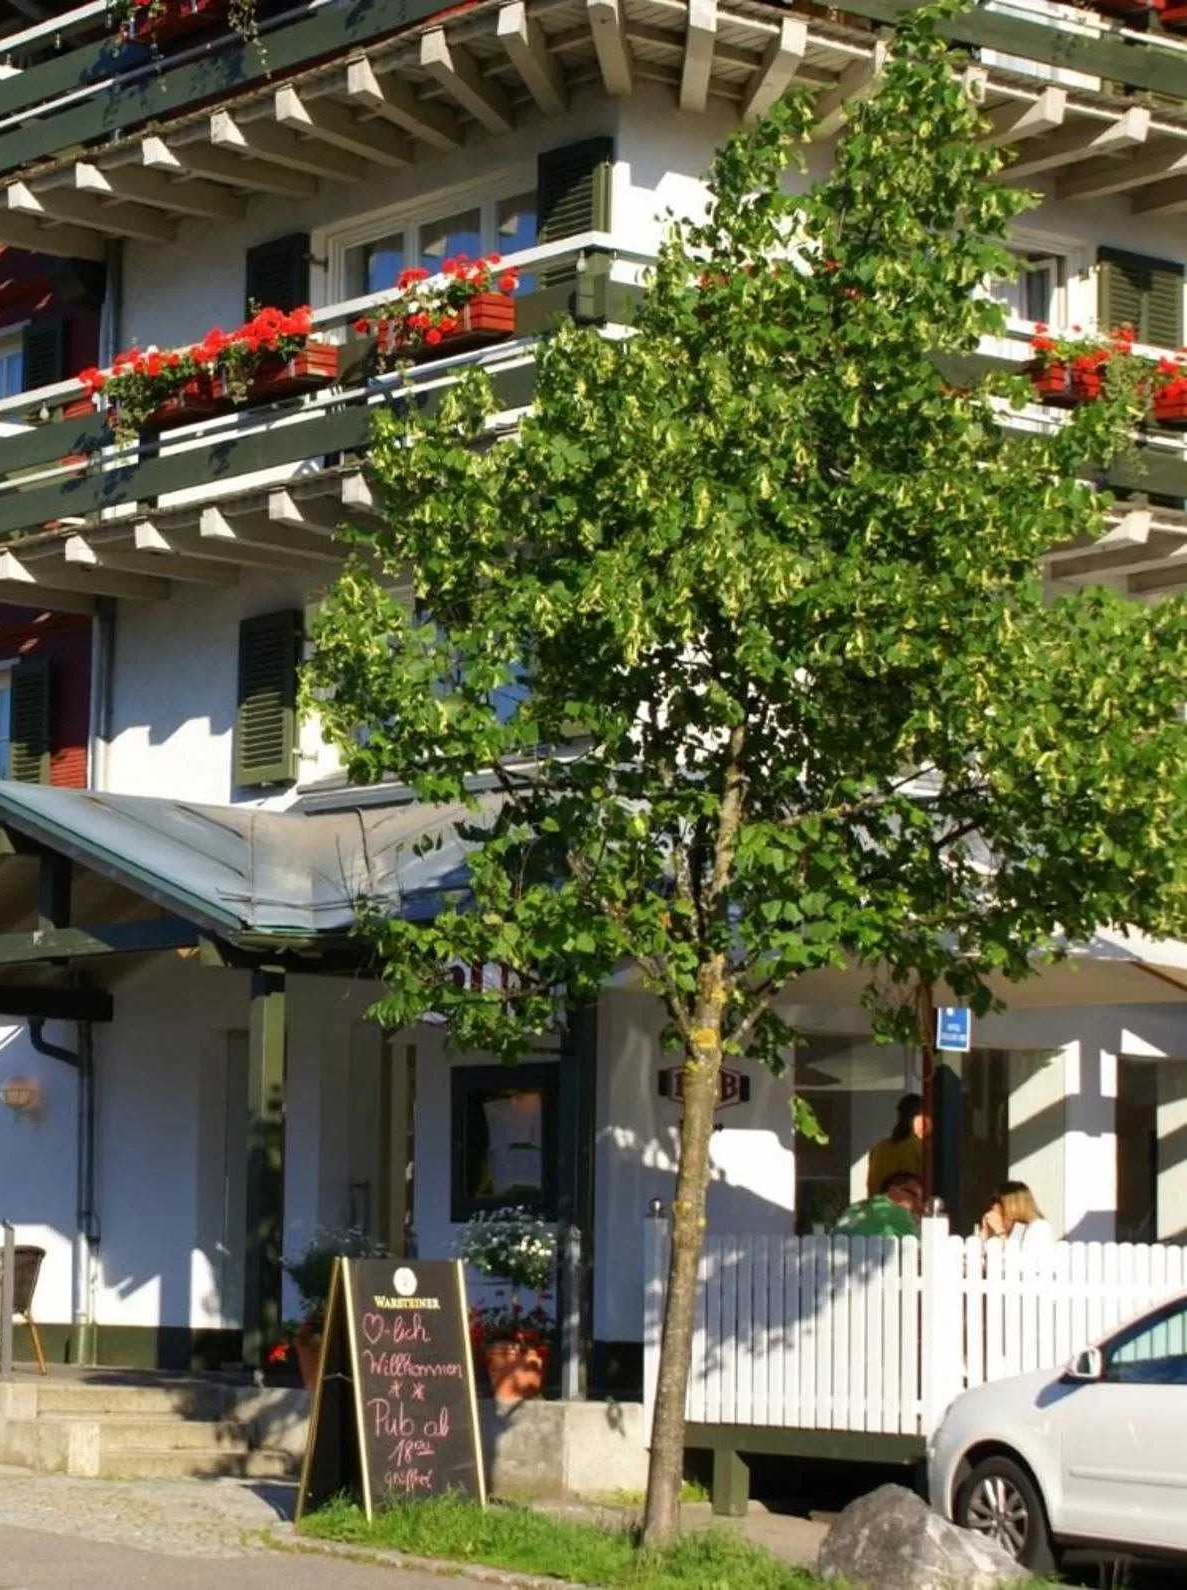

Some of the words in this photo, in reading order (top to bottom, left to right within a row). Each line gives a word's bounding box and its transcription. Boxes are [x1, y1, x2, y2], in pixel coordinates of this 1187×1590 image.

[374, 1295, 441, 1309] WARSTEINER
[361, 1349, 463, 1378] Willkommen
[367, 1398, 415, 1438] Pub
[423, 1406, 451, 1438] ab
